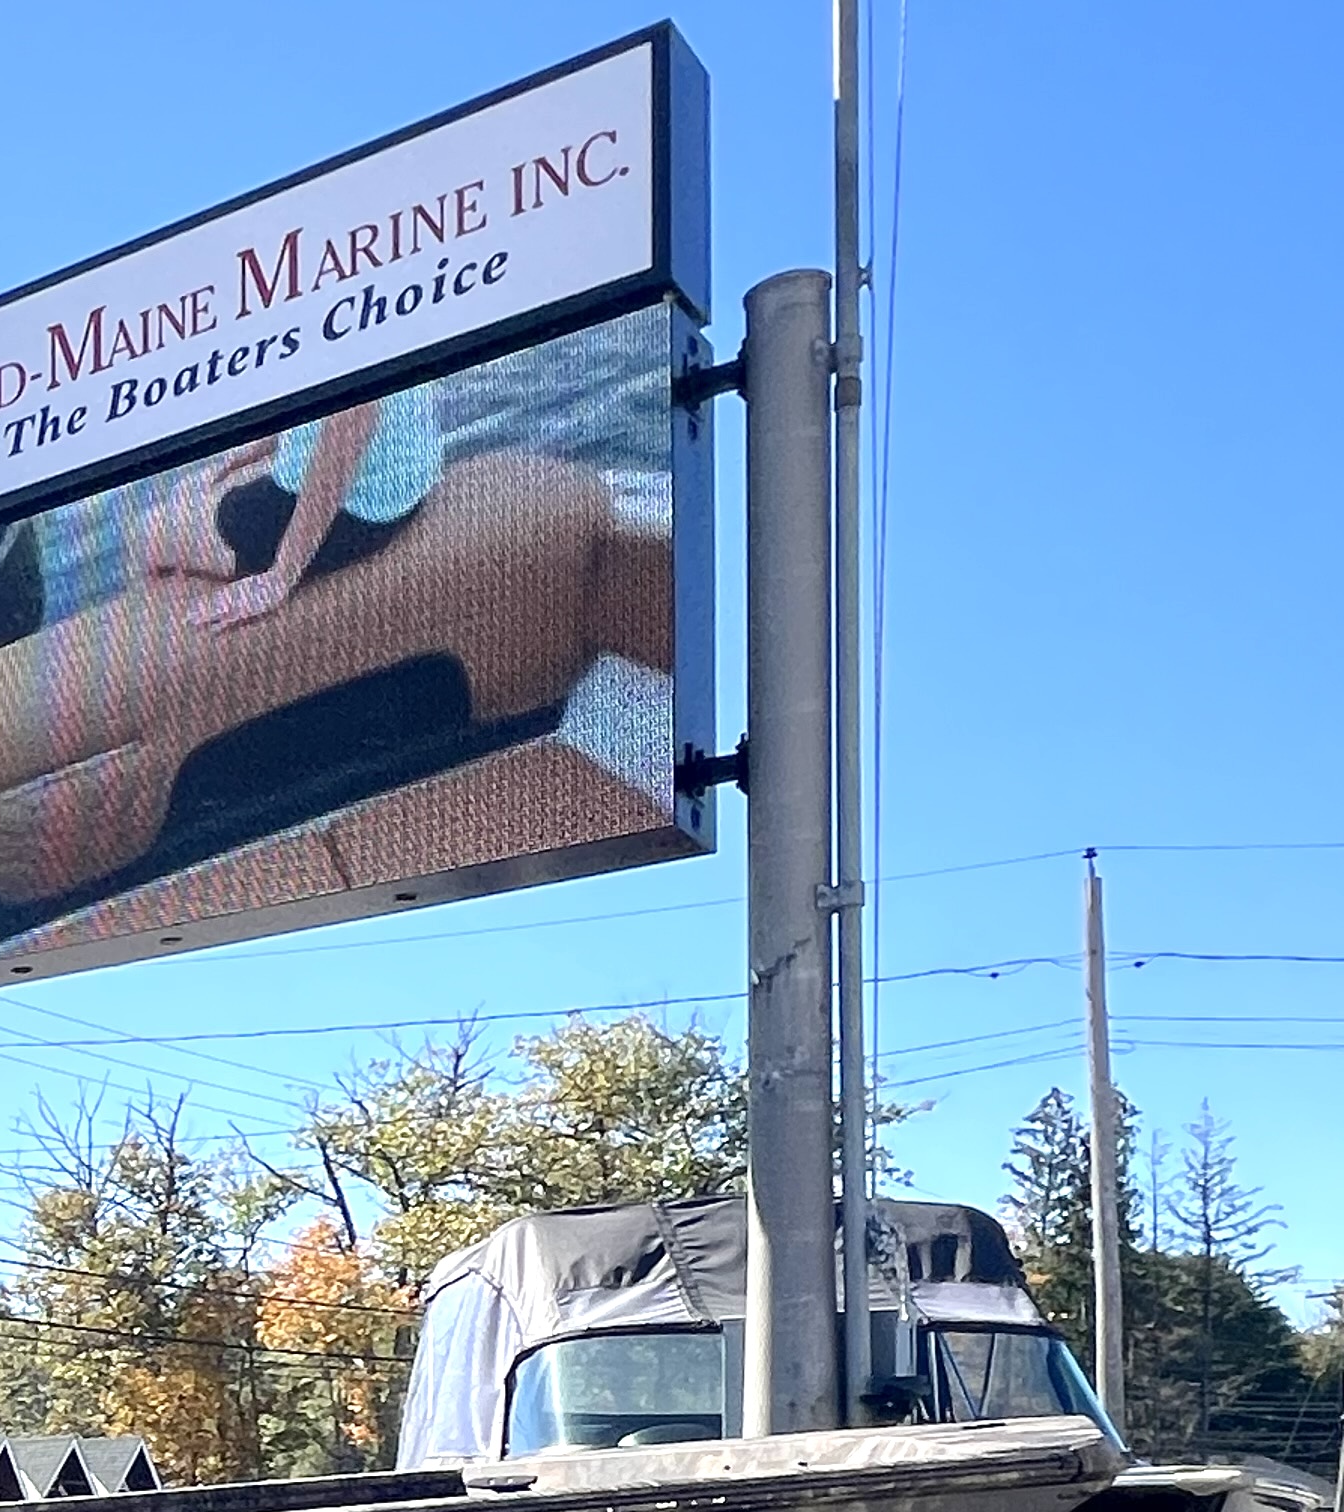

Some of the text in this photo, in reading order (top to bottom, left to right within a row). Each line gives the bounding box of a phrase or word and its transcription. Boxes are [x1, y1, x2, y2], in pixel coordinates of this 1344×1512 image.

[235, 180, 487, 320] MARINE
[510, 130, 630, 217] INC.
[4, 250, 511, 458] The Boaters Choice
